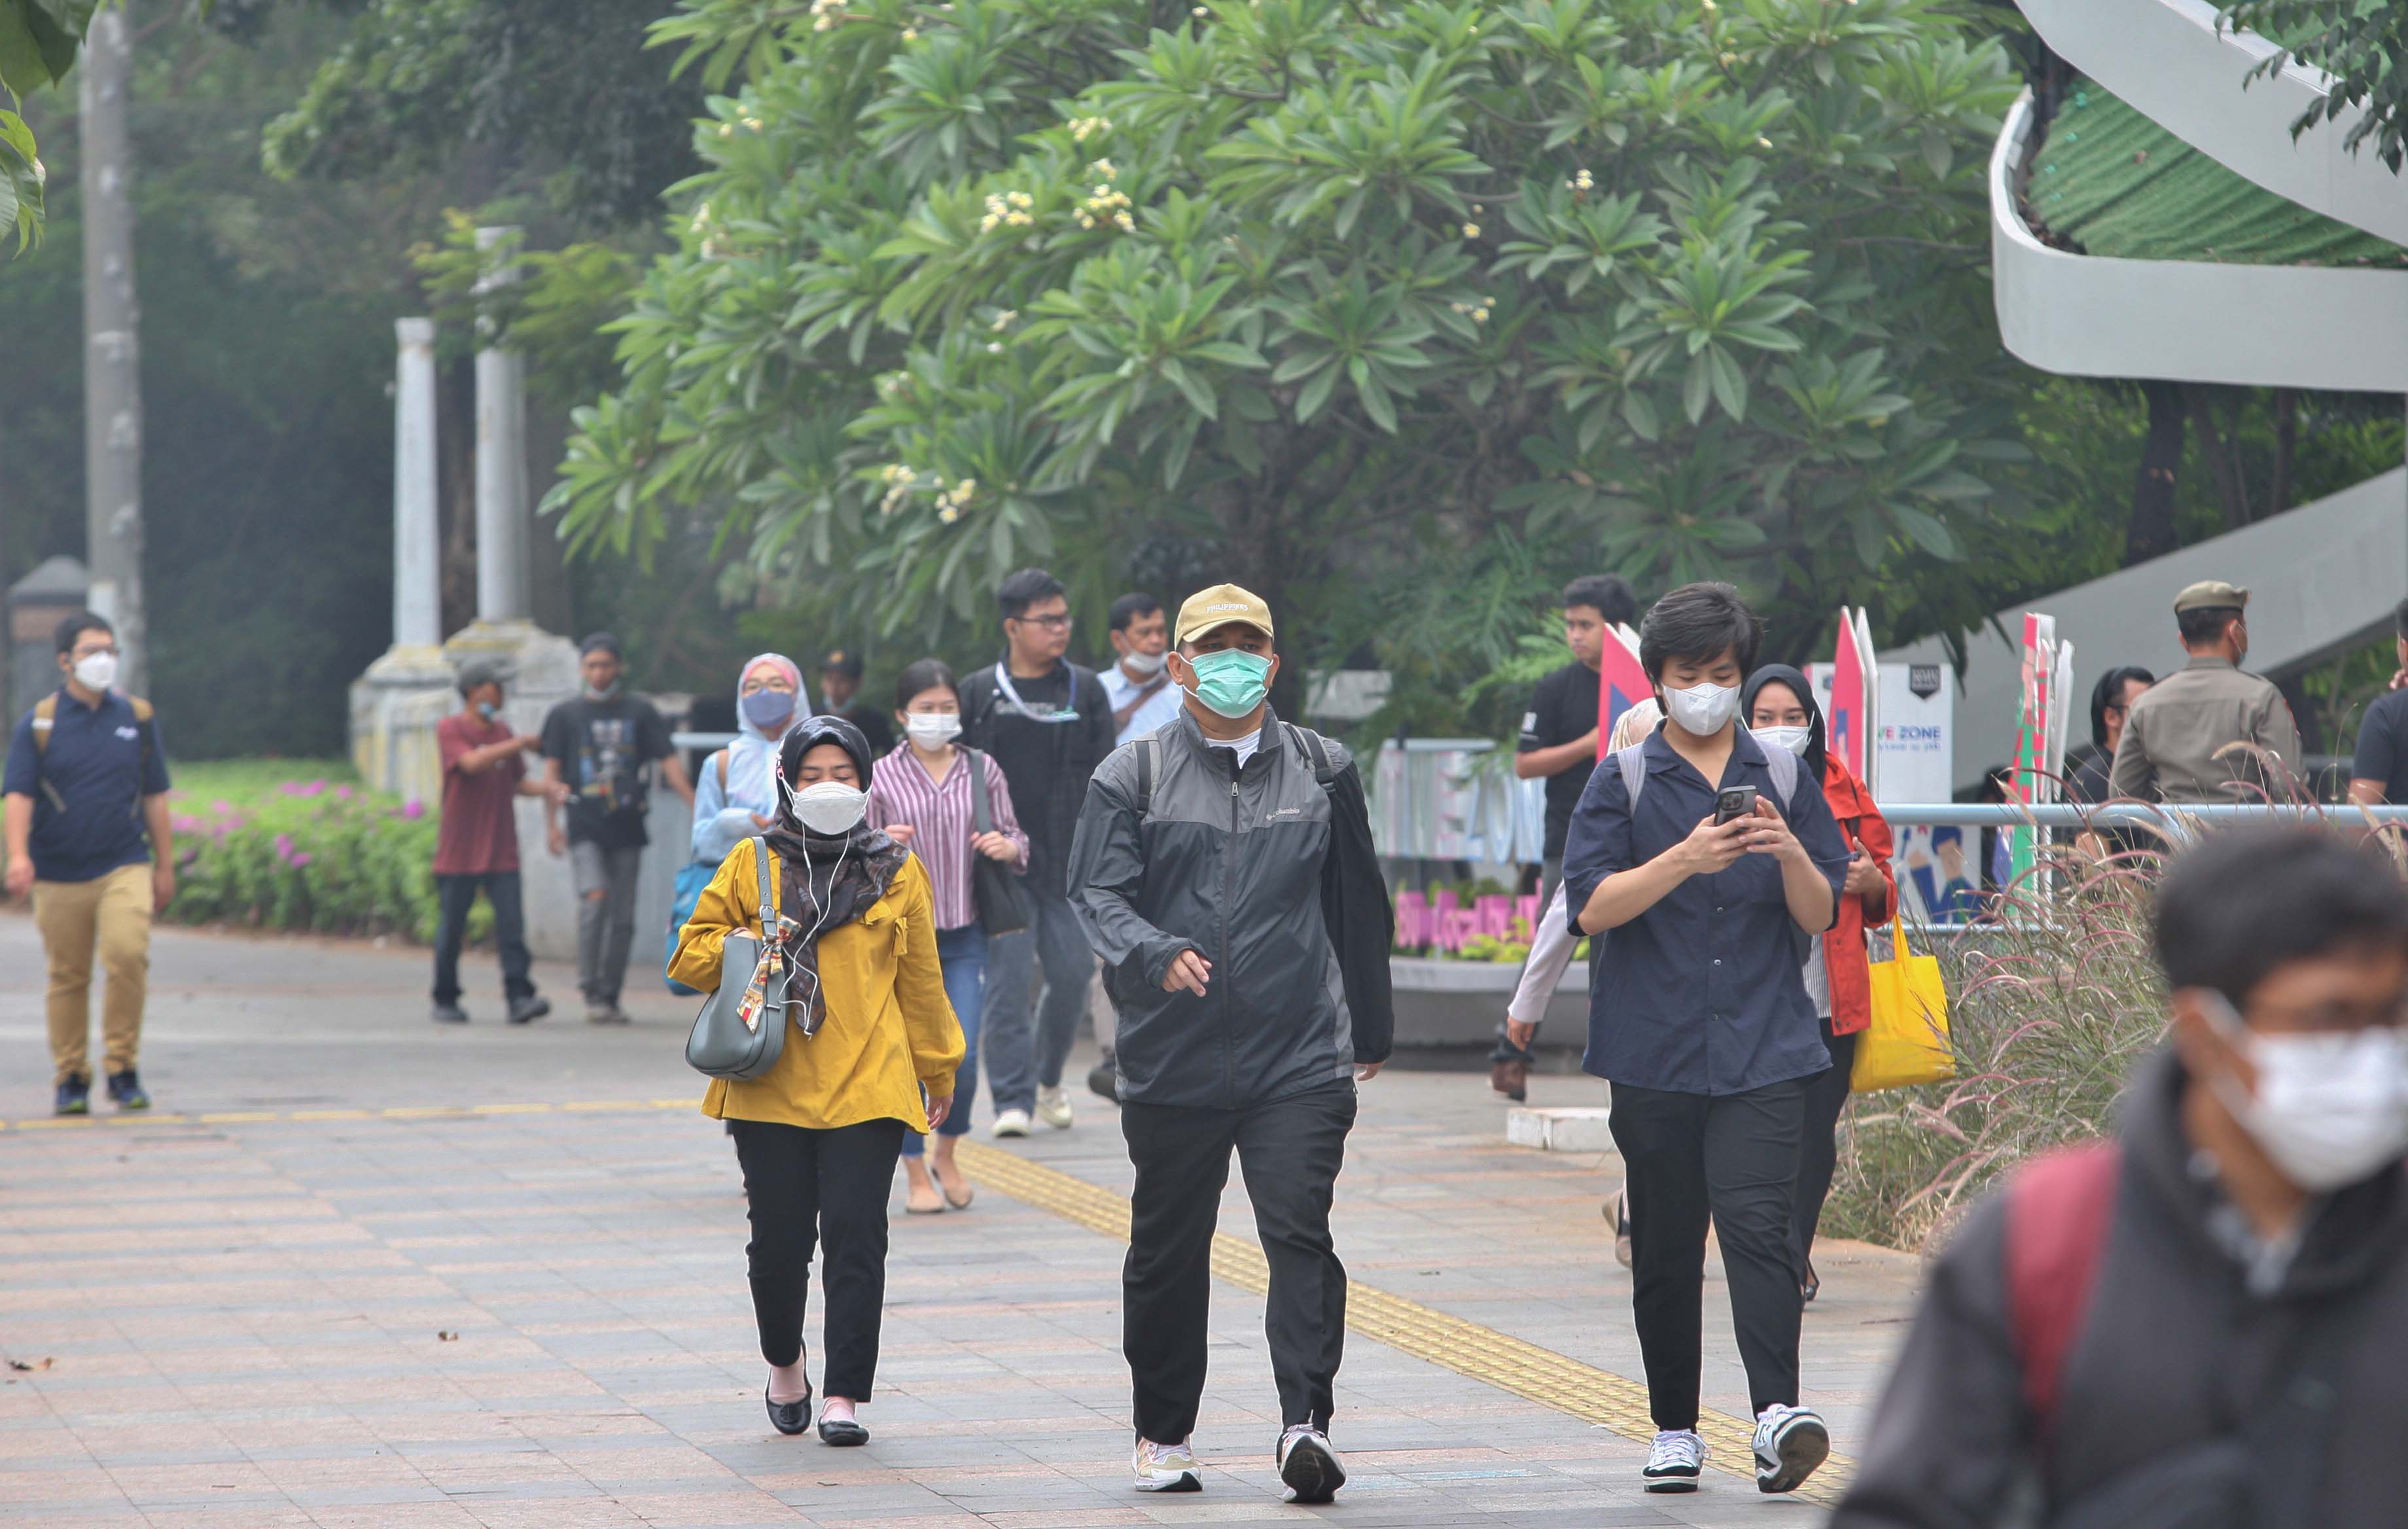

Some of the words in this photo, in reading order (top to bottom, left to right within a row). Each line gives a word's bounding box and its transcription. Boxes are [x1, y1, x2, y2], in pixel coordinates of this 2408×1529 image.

[1207, 603, 1248, 613] PHILIPPINES
[1898, 725, 1941, 740] ZONE
[1273, 807, 1300, 818] Columbia
